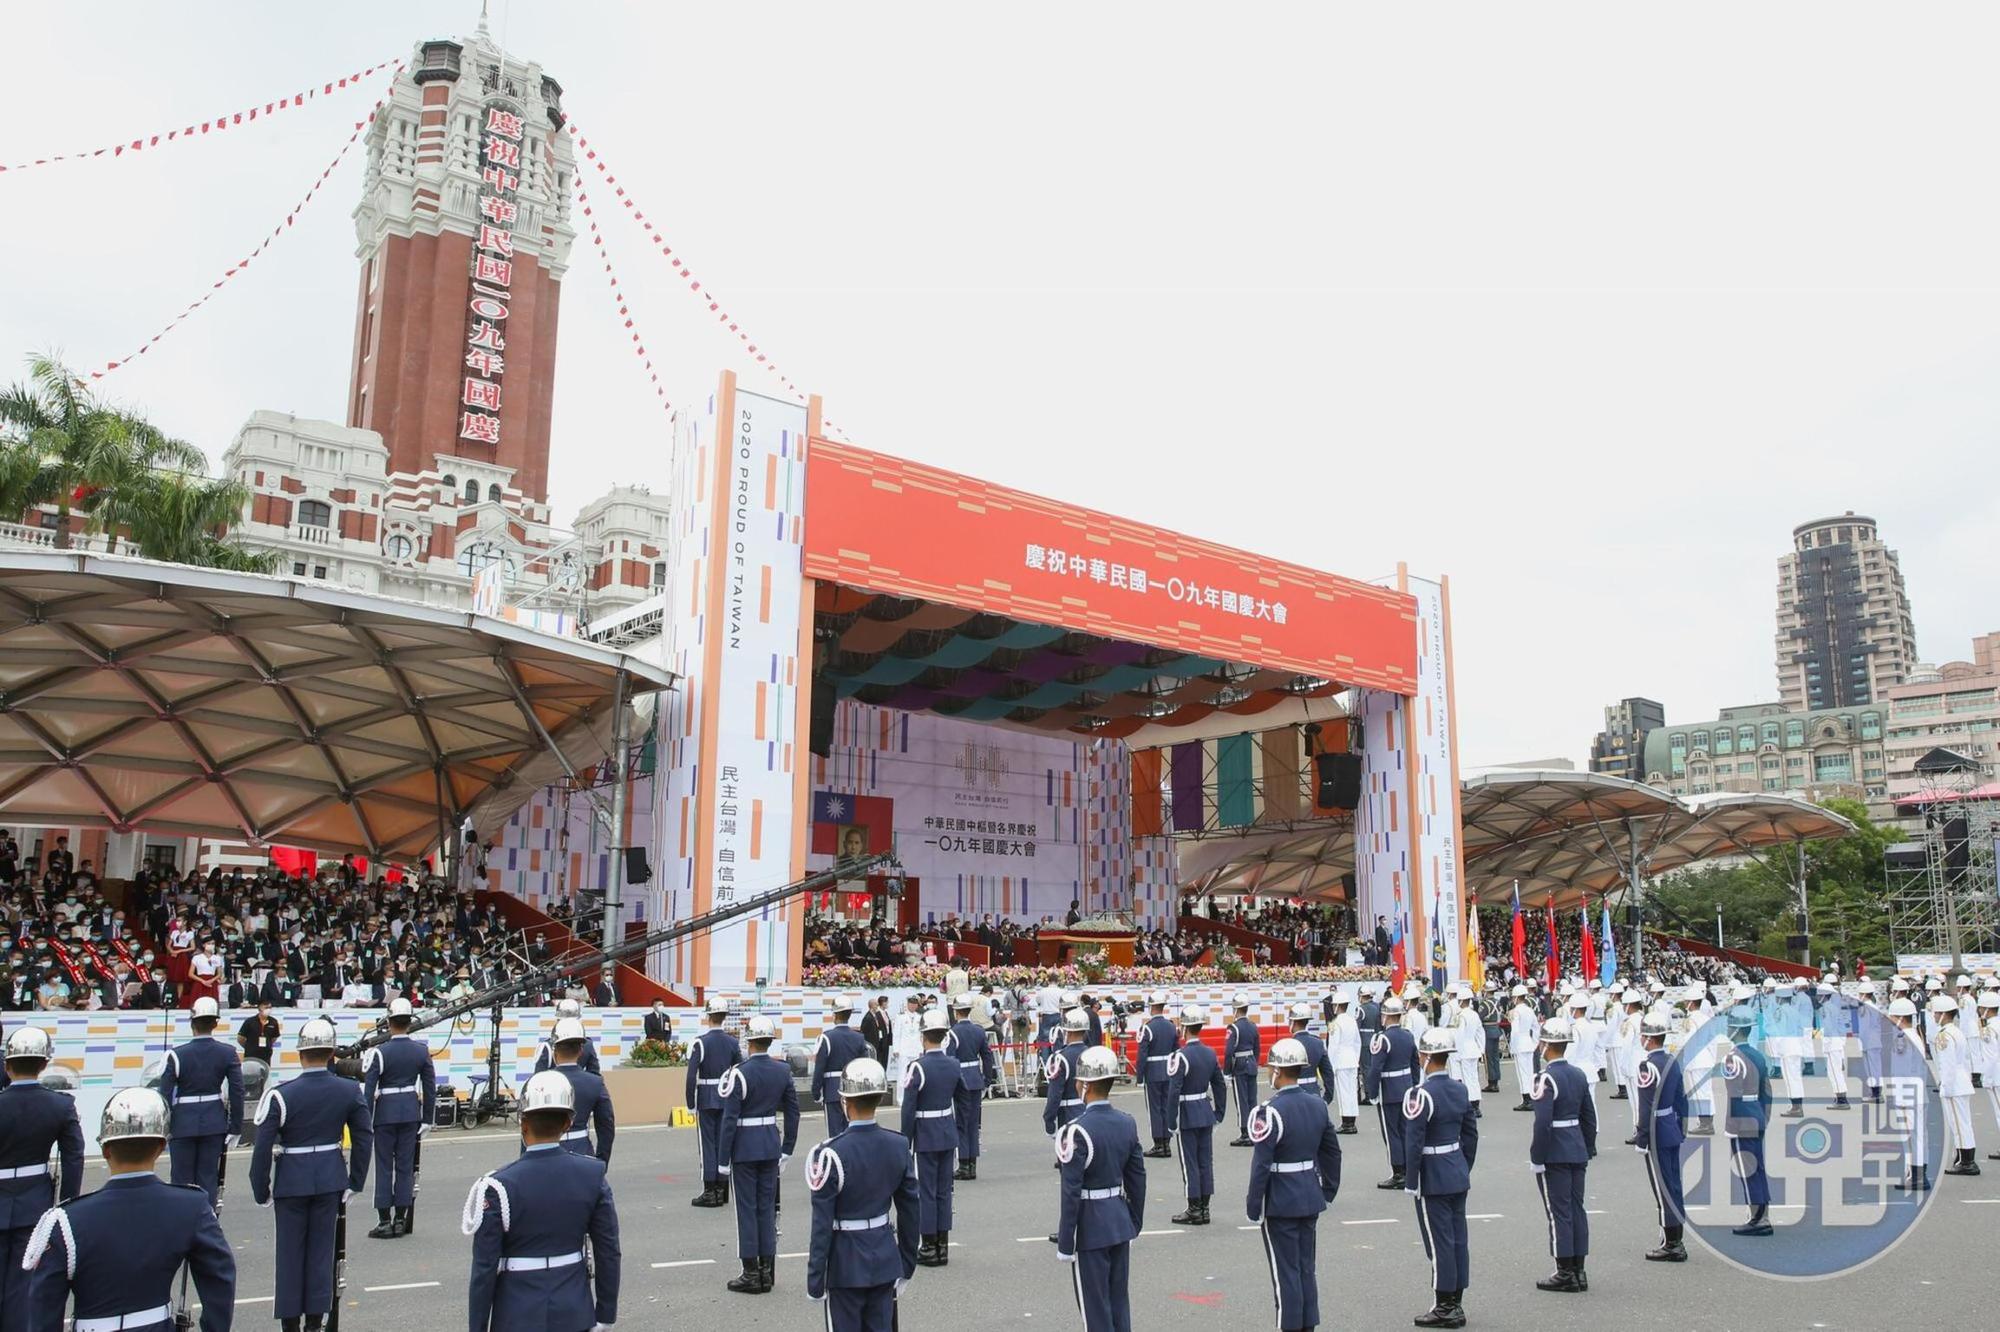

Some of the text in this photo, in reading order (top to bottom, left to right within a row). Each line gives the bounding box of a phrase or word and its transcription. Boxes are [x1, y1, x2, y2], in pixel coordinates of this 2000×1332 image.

[730, 409, 752, 649] 2020 PROUD OF TAIWAN
[1439, 709, 1447, 759] TAIWAN
